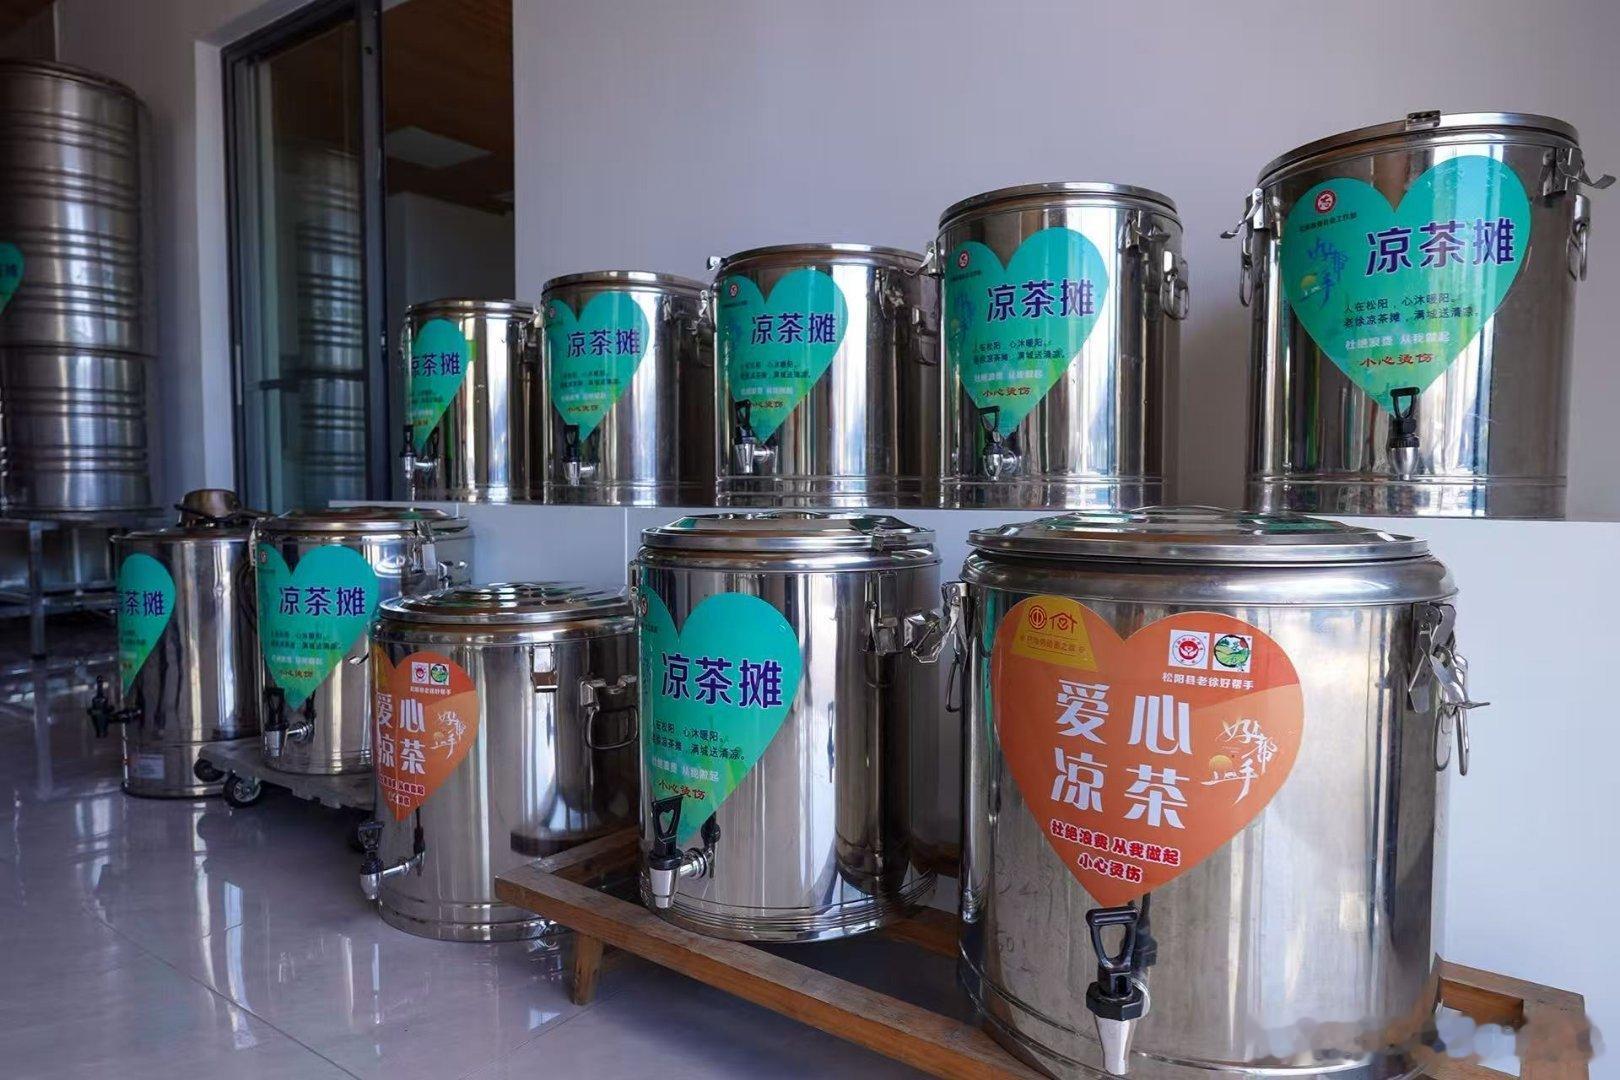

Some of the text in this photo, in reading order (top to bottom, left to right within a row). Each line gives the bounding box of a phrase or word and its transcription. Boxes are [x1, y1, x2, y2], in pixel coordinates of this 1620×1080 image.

[1365, 217, 1515, 276] 凉茶摊
[987, 279, 1095, 322] 凉茶摊
[567, 328, 641, 358] 凉茶摊
[751, 313, 837, 345] 凉茶摊
[1360, 353, 1433, 367] 小心烫伤
[279, 586, 366, 617] 凉茶摊
[662, 652, 783, 709] 凉茶摊
[1162, 672, 1254, 691] 松阳县老徐好帮手
[1055, 679, 1194, 755] 爱心
[1050, 747, 1190, 829] 凉茶
[1051, 819, 1181, 866] 杜绝浪费 从我做起
[1078, 852, 1143, 883] 小心烫伤
